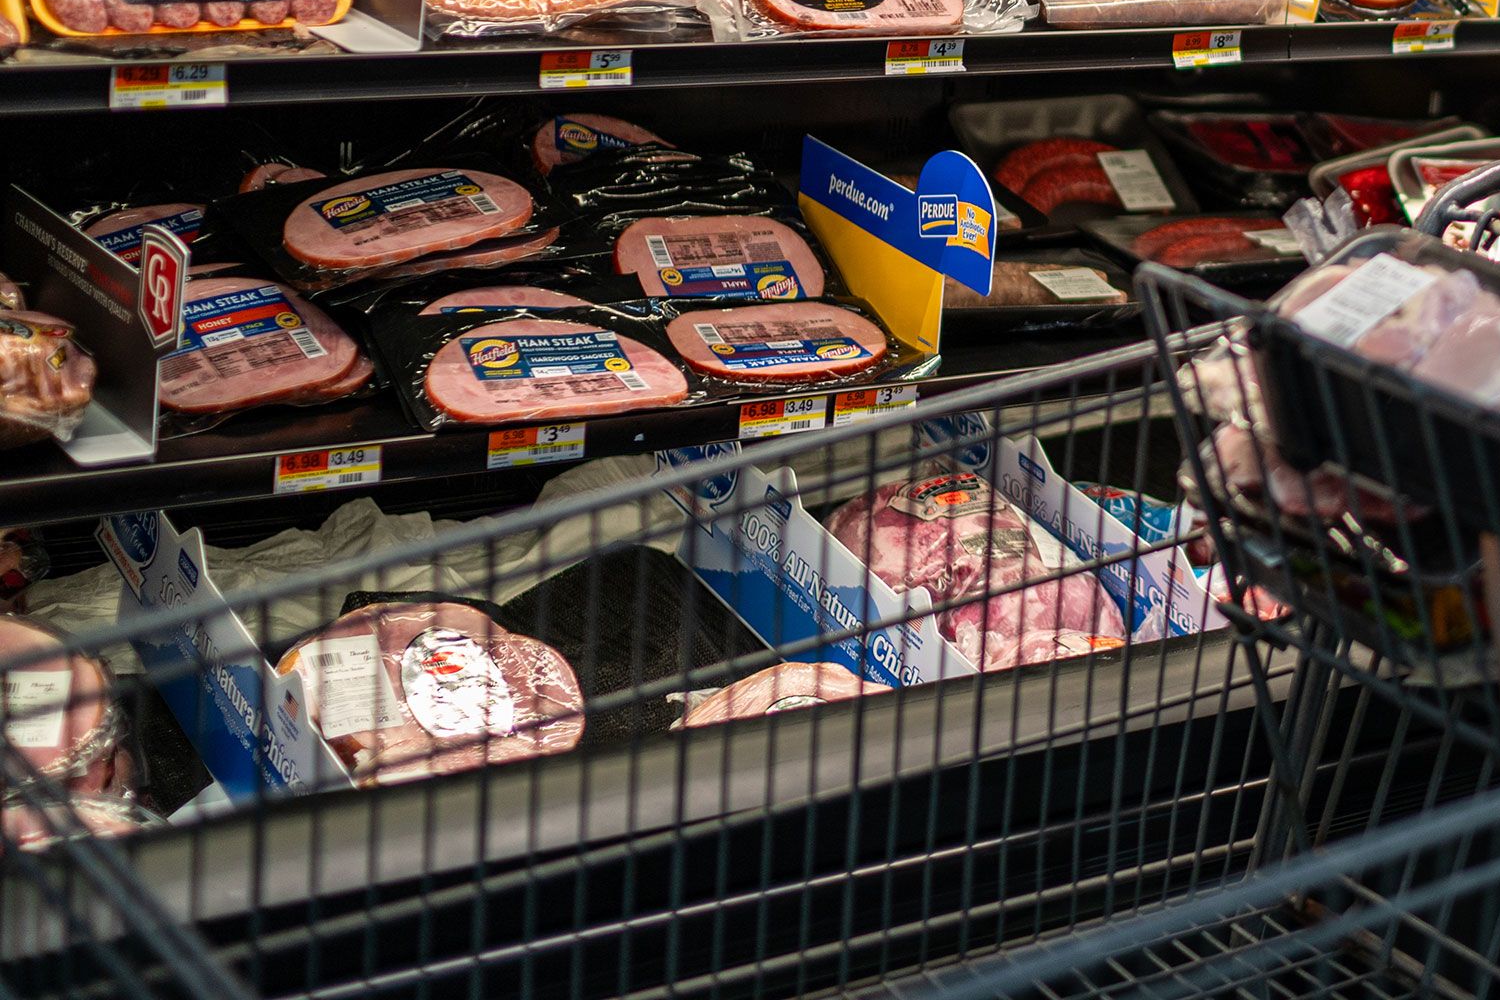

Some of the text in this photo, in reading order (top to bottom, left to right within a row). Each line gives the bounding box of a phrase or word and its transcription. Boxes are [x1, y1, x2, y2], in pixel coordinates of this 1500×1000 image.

[366, 176, 443, 197] HAM STEAK
[382, 182, 464, 203] HARDWOOD SMOKED
[322, 194, 368, 219] Hatfield
[921, 201, 955, 218] PERDUE
[966, 207, 976, 219] No
[15, 211, 57, 251] CHAIRMAN'S
[959, 217, 986, 236] Antibiotics
[962, 228, 977, 242] Ever!
[101, 231, 135, 249] HAM
[722, 280, 748, 289] MAPLE
[759, 275, 798, 300] Hatfield
[181, 291, 260, 317] HAM STEAK
[197, 316, 234, 330] HONEY
[517, 335, 594, 348] HAM STEAK
[471, 342, 518, 366] Hatfield
[531, 352, 616, 363] HARDWOOD SMOKED
[820, 344, 862, 360] Hatfield
[750, 355, 820, 368] HAM STEAK
[846, 391, 865, 401] 6.98
[1003, 473, 1048, 522] 100%
[1050, 510, 1078, 541] All
[741, 511, 785, 565] 100%
[783, 550, 810, 588] All
[808, 570, 871, 650] Natural
[210, 645, 263, 738] Natural
